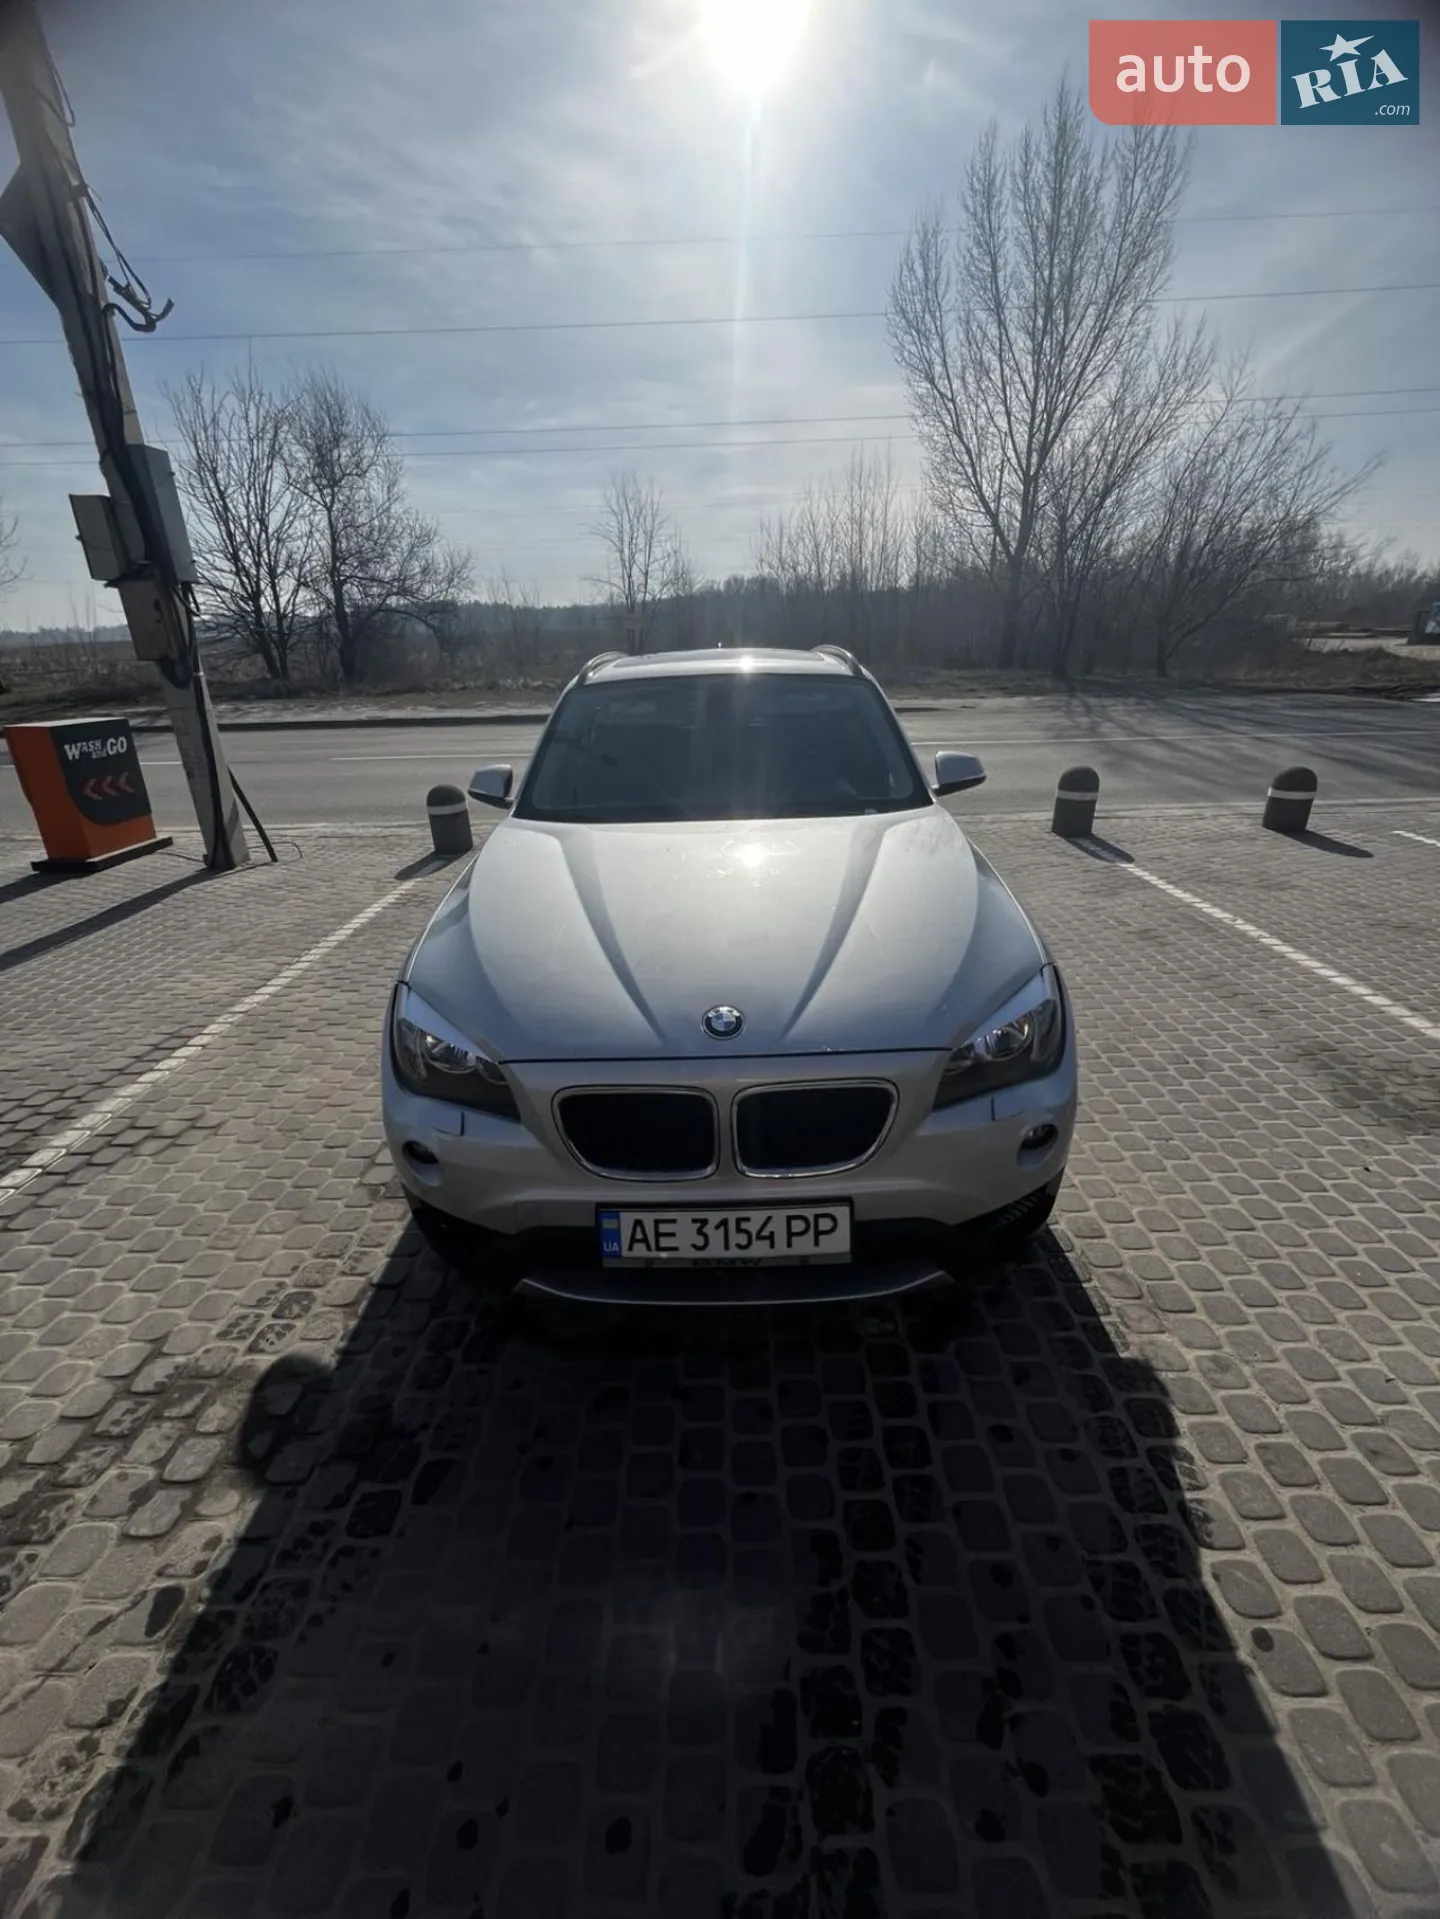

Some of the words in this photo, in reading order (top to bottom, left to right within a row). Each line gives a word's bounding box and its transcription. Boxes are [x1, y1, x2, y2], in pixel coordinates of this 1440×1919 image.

[107, 737, 127, 755] GO
[627, 1218, 680, 1252] AE
[690, 1215, 775, 1252] 3154
[785, 1212, 839, 1249] PP
[603, 1241, 620, 1253] UA
